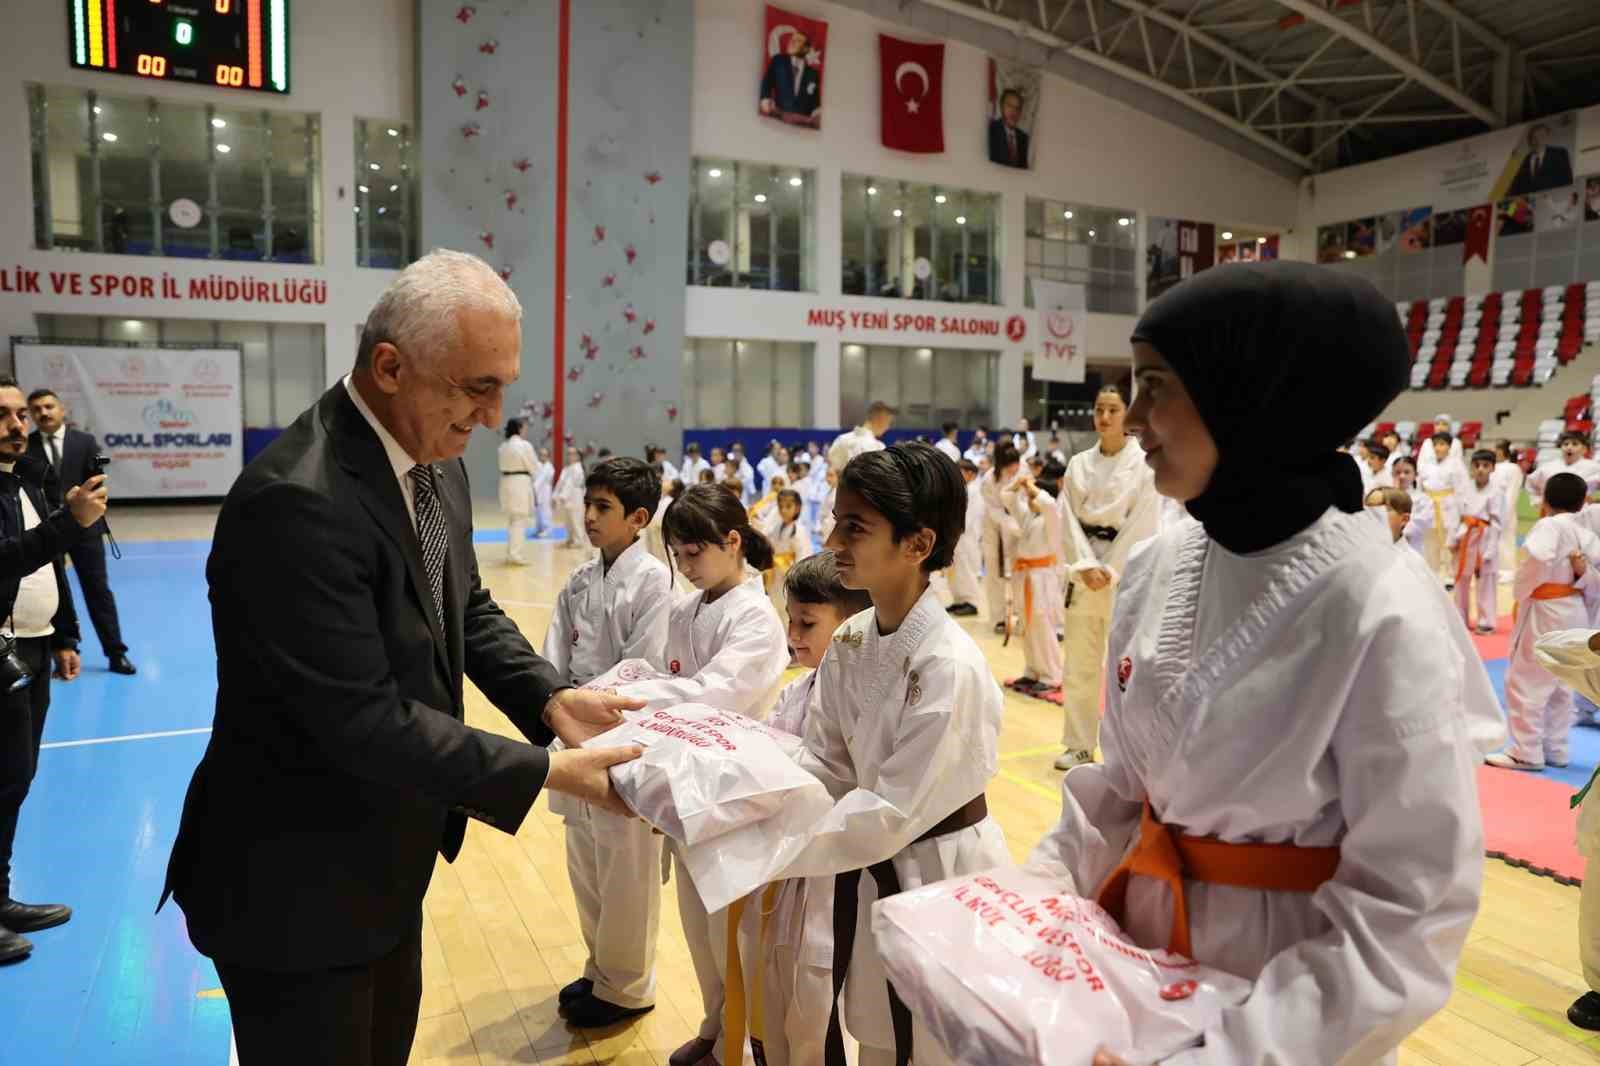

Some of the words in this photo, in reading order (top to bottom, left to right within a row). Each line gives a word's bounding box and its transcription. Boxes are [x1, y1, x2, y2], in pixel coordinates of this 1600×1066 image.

[175, 22, 192, 45] 0
[137, 54, 166, 76] 00
[216, 64, 244, 87] 00
[49, 272, 81, 295] VE
[89, 274, 154, 299] SPOR
[161, 271, 182, 299] İL
[189, 273, 328, 304] MÜDÜRLÜĞÜ
[808, 309, 846, 333] MUŞ
[850, 308, 889, 330] YENİ
[893, 313, 936, 332] SPOR
[940, 316, 1000, 336] SALONU
